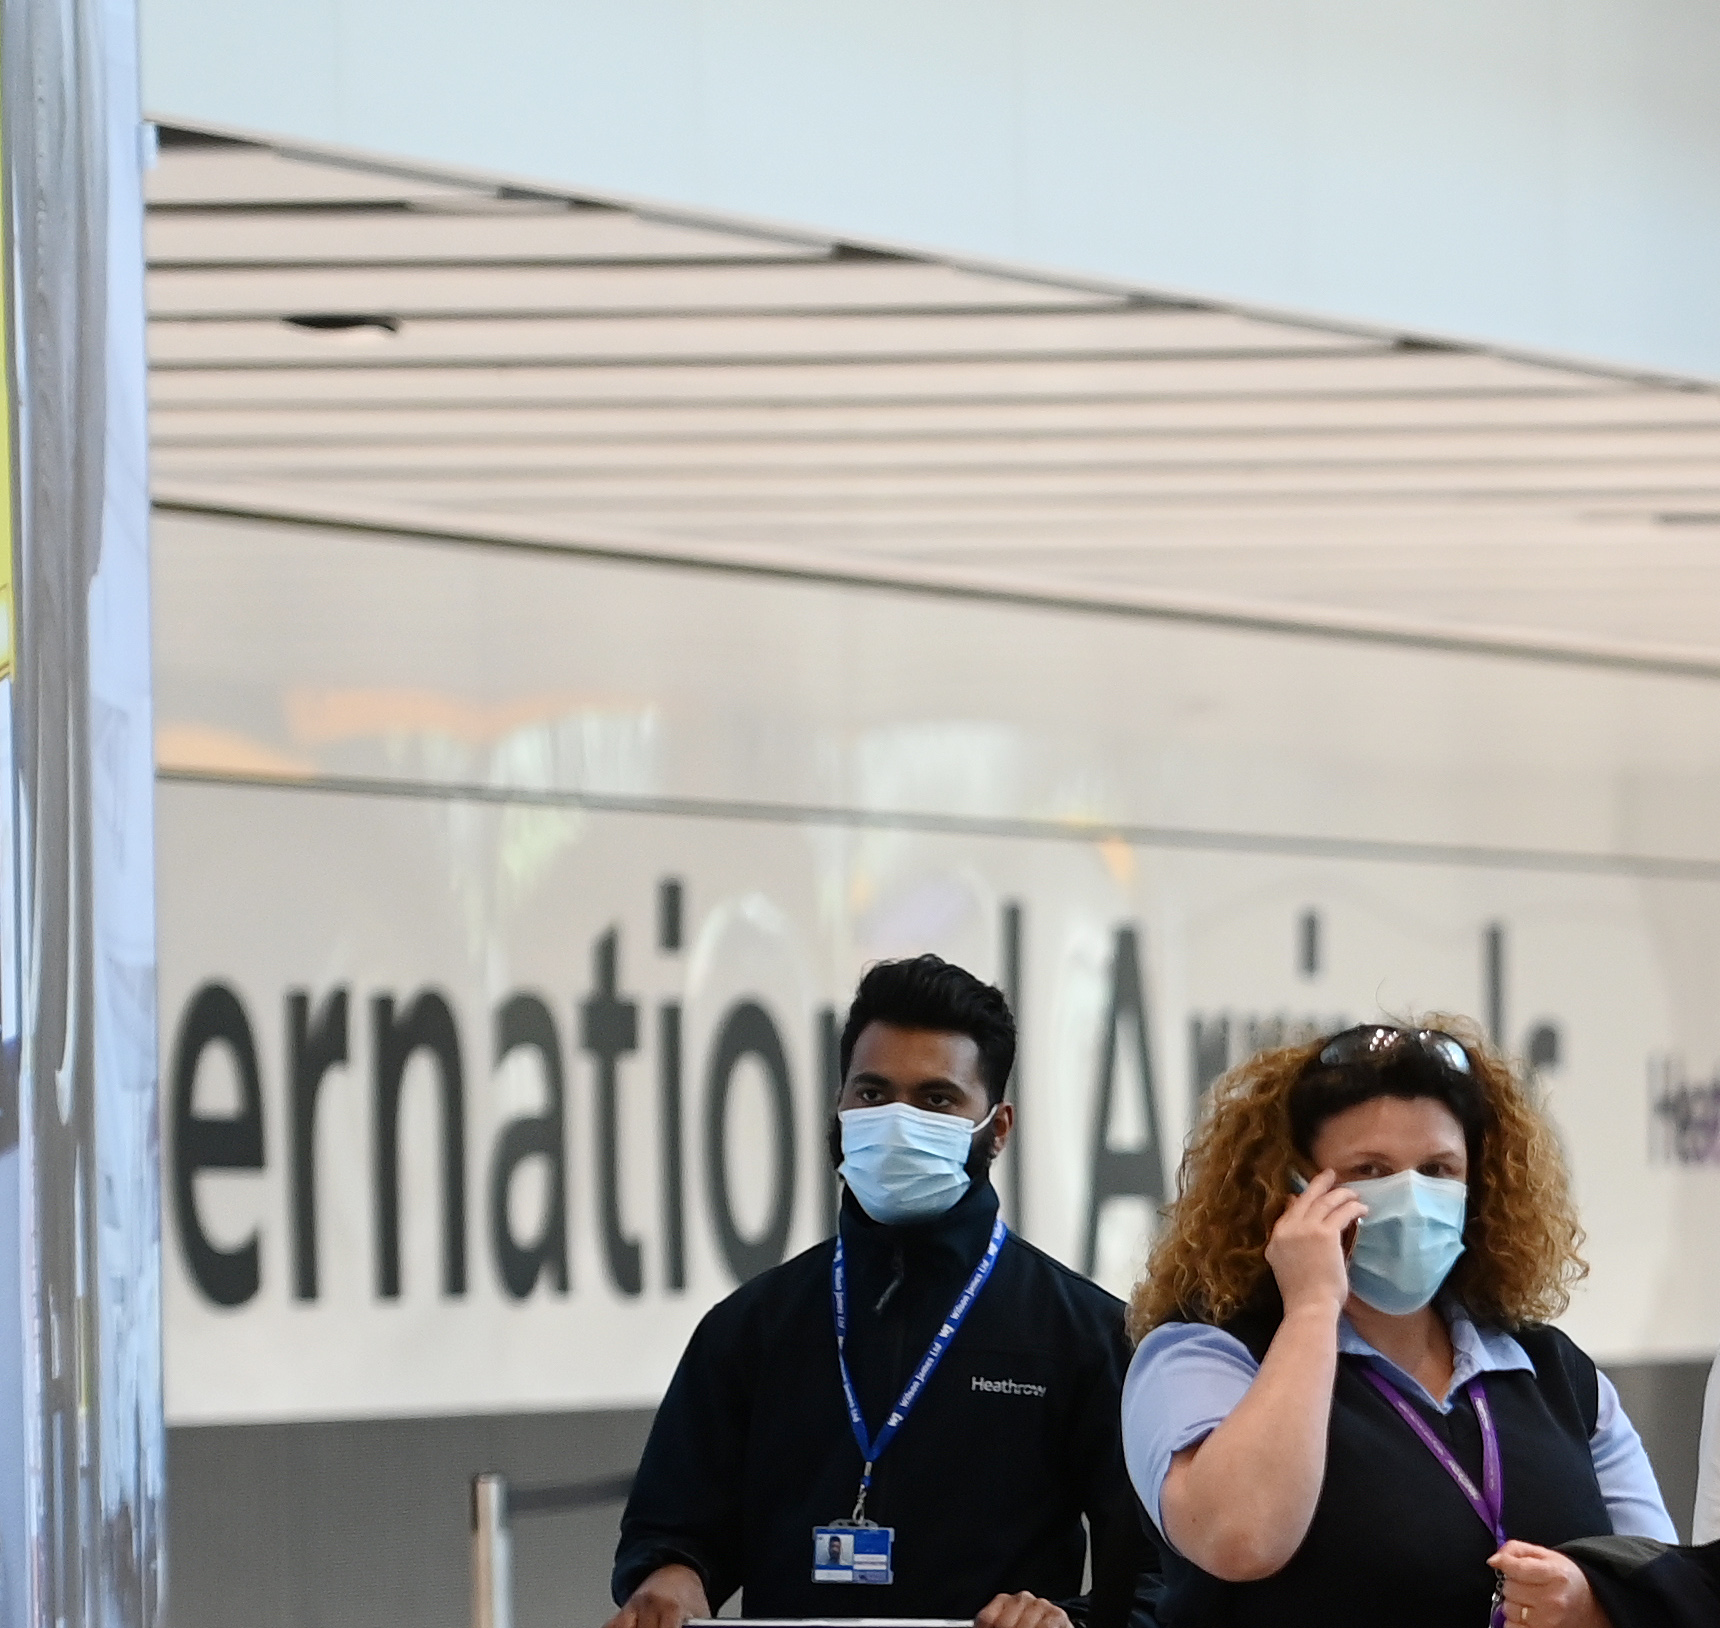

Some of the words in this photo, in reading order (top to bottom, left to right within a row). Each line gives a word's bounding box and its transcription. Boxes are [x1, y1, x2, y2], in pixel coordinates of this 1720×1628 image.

[166, 876, 1024, 1315] ernatiol
[950, 1295, 971, 1320] Wilson
[965, 1273, 983, 1297] James
[977, 1258, 990, 1274] Ltd
[899, 1380, 920, 1408] Wilson
[915, 1356, 935, 1383] James
[929, 1341, 943, 1358] Ltd
[971, 1376, 1047, 1397] Heathrow
